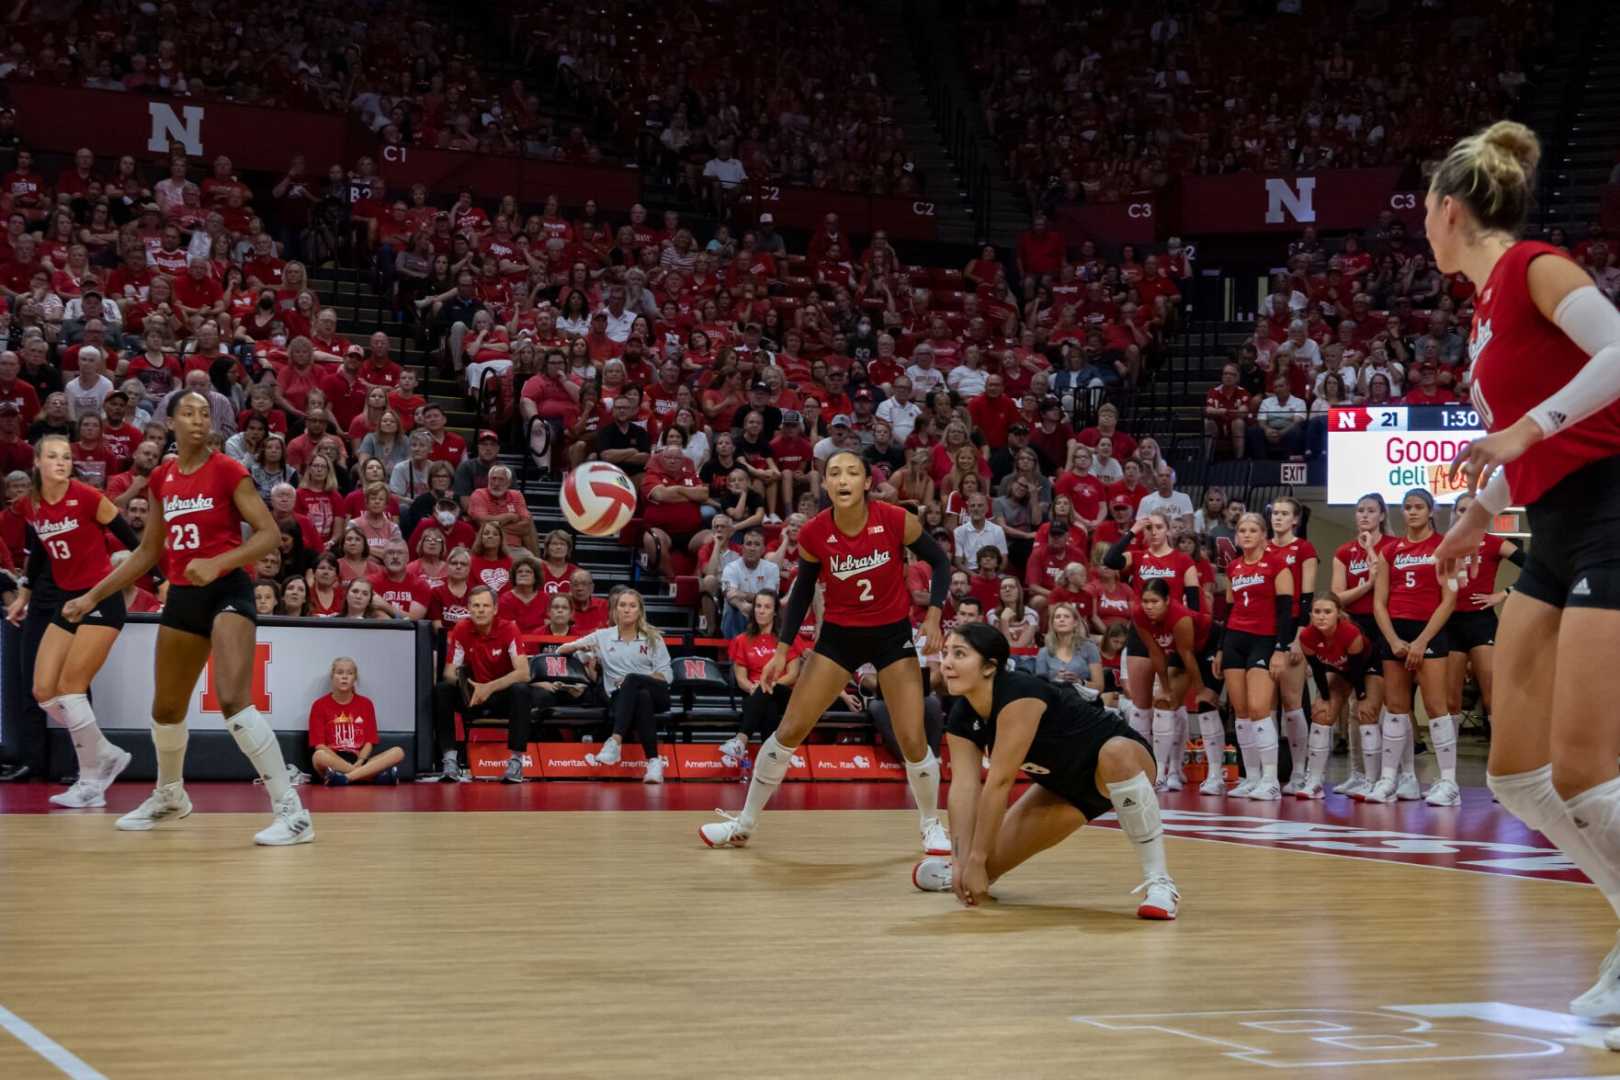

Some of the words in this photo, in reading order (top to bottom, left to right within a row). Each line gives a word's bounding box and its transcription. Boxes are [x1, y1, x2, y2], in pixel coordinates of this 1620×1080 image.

[148, 102, 204, 156] N
[383, 145, 407, 163] C1
[1265, 177, 1316, 223] N
[1390, 194, 1416, 209] C3
[912, 202, 935, 215] C2
[1128, 203, 1152, 218] C3
[1338, 412, 1356, 428] N
[1381, 412, 1398, 427] 21
[1441, 411, 1479, 427] 1:30
[1283, 466, 1305, 481] EXIT
[1389, 466, 1426, 485] deli
[171, 523, 200, 551] 23
[48, 540, 72, 559] 13
[829, 549, 892, 574] Nebraska
[1405, 571, 1417, 588] 5
[856, 578, 875, 602] 2
[1243, 591, 1249, 608] 1
[546, 656, 567, 677] N
[684, 660, 706, 679] N
[478, 759, 508, 768] Amerit
[548, 759, 588, 768] Ameritas
[621, 760, 648, 768] merita
[685, 759, 722, 768] Ameritas
[818, 760, 854, 769] Amitas
